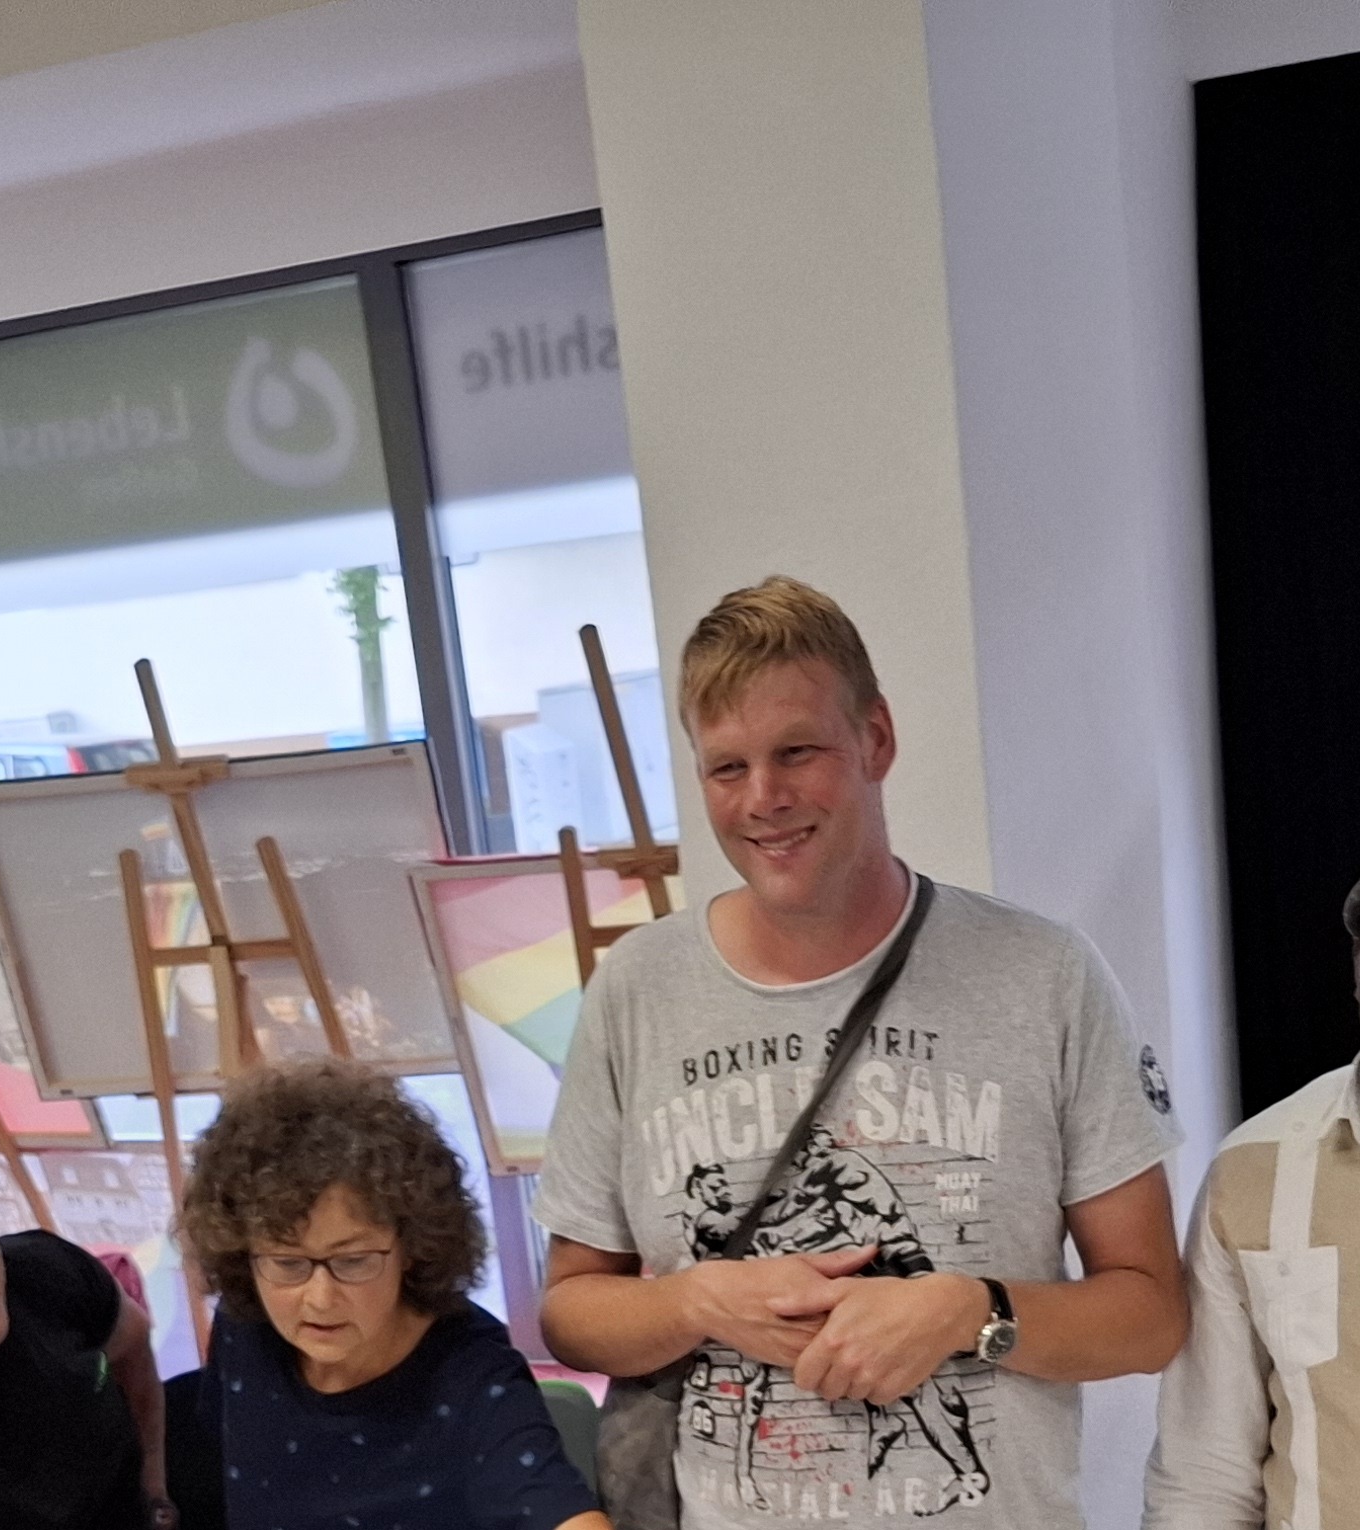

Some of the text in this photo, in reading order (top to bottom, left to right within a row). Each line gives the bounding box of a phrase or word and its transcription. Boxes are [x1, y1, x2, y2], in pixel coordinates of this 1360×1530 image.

[682, 1024, 940, 1086] BOXING SIRIT
[855, 1060, 1003, 1163] SAM
